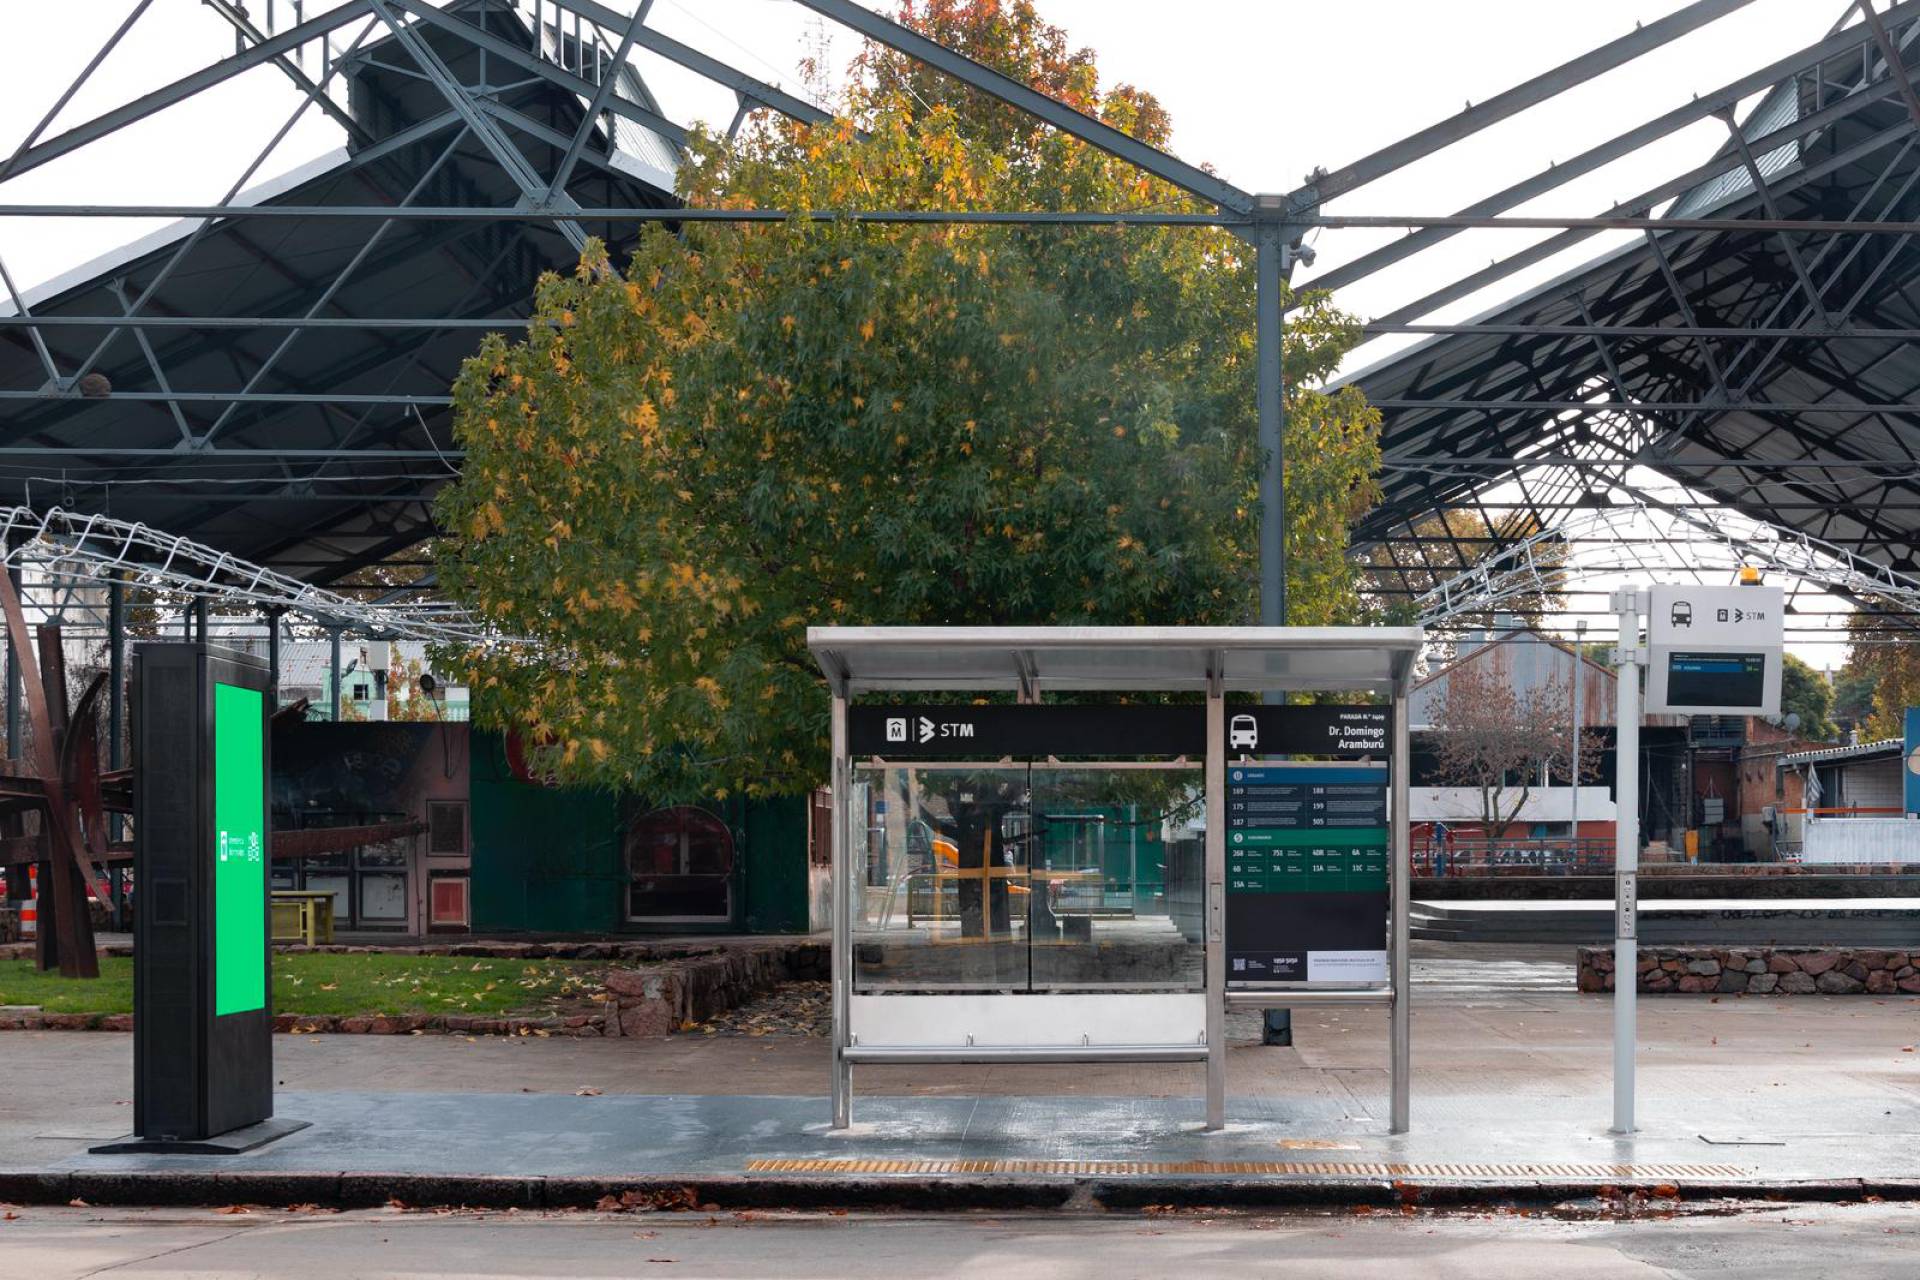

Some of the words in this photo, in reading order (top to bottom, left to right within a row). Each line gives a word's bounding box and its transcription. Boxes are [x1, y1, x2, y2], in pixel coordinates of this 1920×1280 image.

[1746, 611, 1765, 621] STM
[940, 723, 974, 738] STM
[1329, 725, 1342, 736] Dr.
[1344, 725, 1385, 738] Domingo
[1338, 738, 1385, 749] Aramburú
